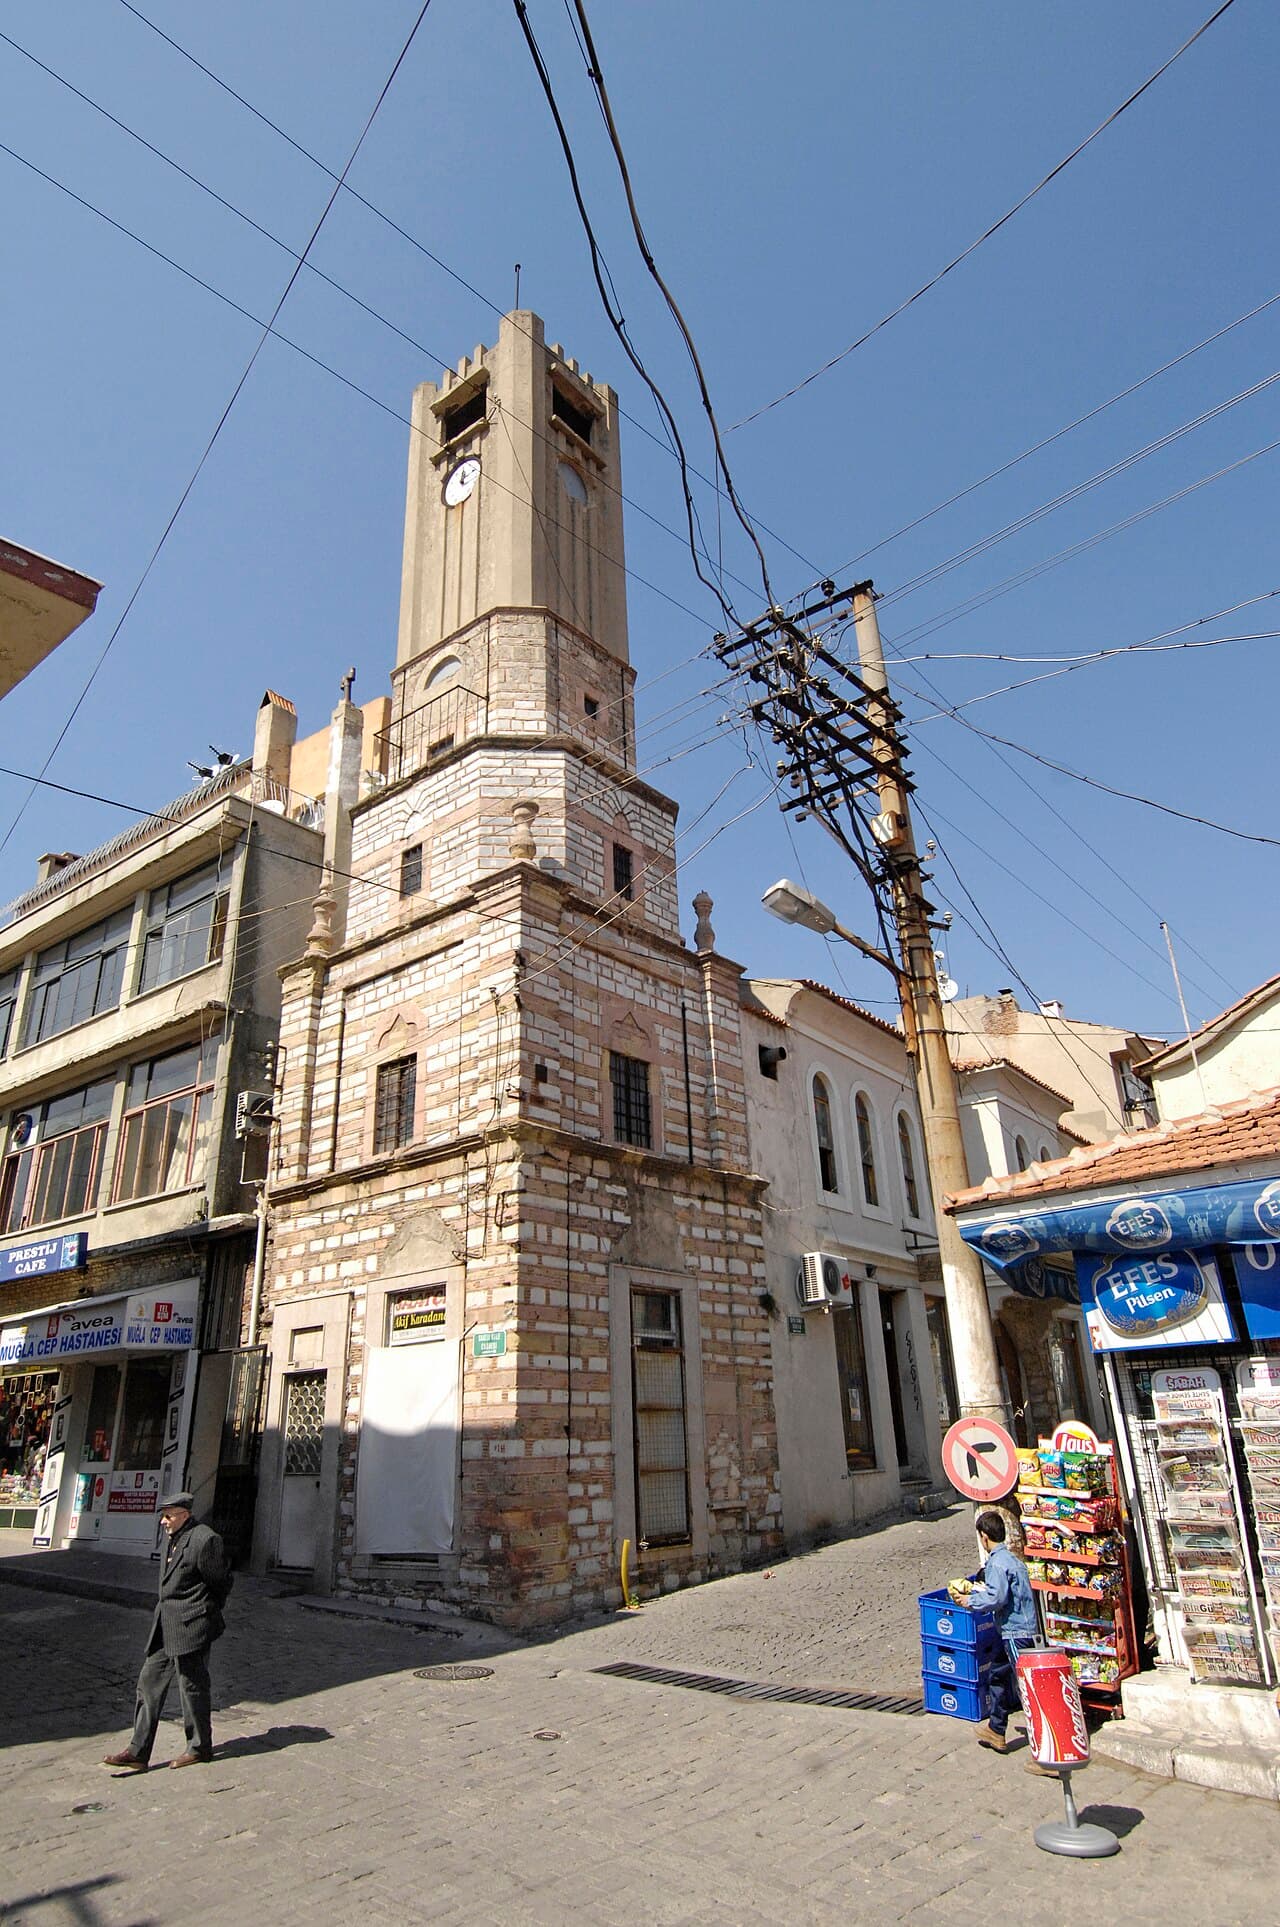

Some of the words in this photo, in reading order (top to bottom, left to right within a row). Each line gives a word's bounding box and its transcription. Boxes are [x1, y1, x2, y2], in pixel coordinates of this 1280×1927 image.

[1115, 1210, 1154, 1236] EFES
[8, 1241, 58, 1263] PRESTİJ
[15, 1258, 47, 1275] CAFE
[1106, 1253, 1179, 1300] EFES
[1125, 1287, 1176, 1314] Pilsen
[70, 1316, 114, 1331] avea
[176, 1316, 193, 1324] avea
[0, 1339, 34, 1361] MUĞLA
[37, 1337, 57, 1355] CEP
[59, 1327, 122, 1353] HASTANESİ
[127, 1324, 145, 1343] MUĞLA
[150, 1326, 160, 1344] CEP
[163, 1326, 193, 1344] HASTANESİ
[1167, 1377, 1204, 1390] SABAH
